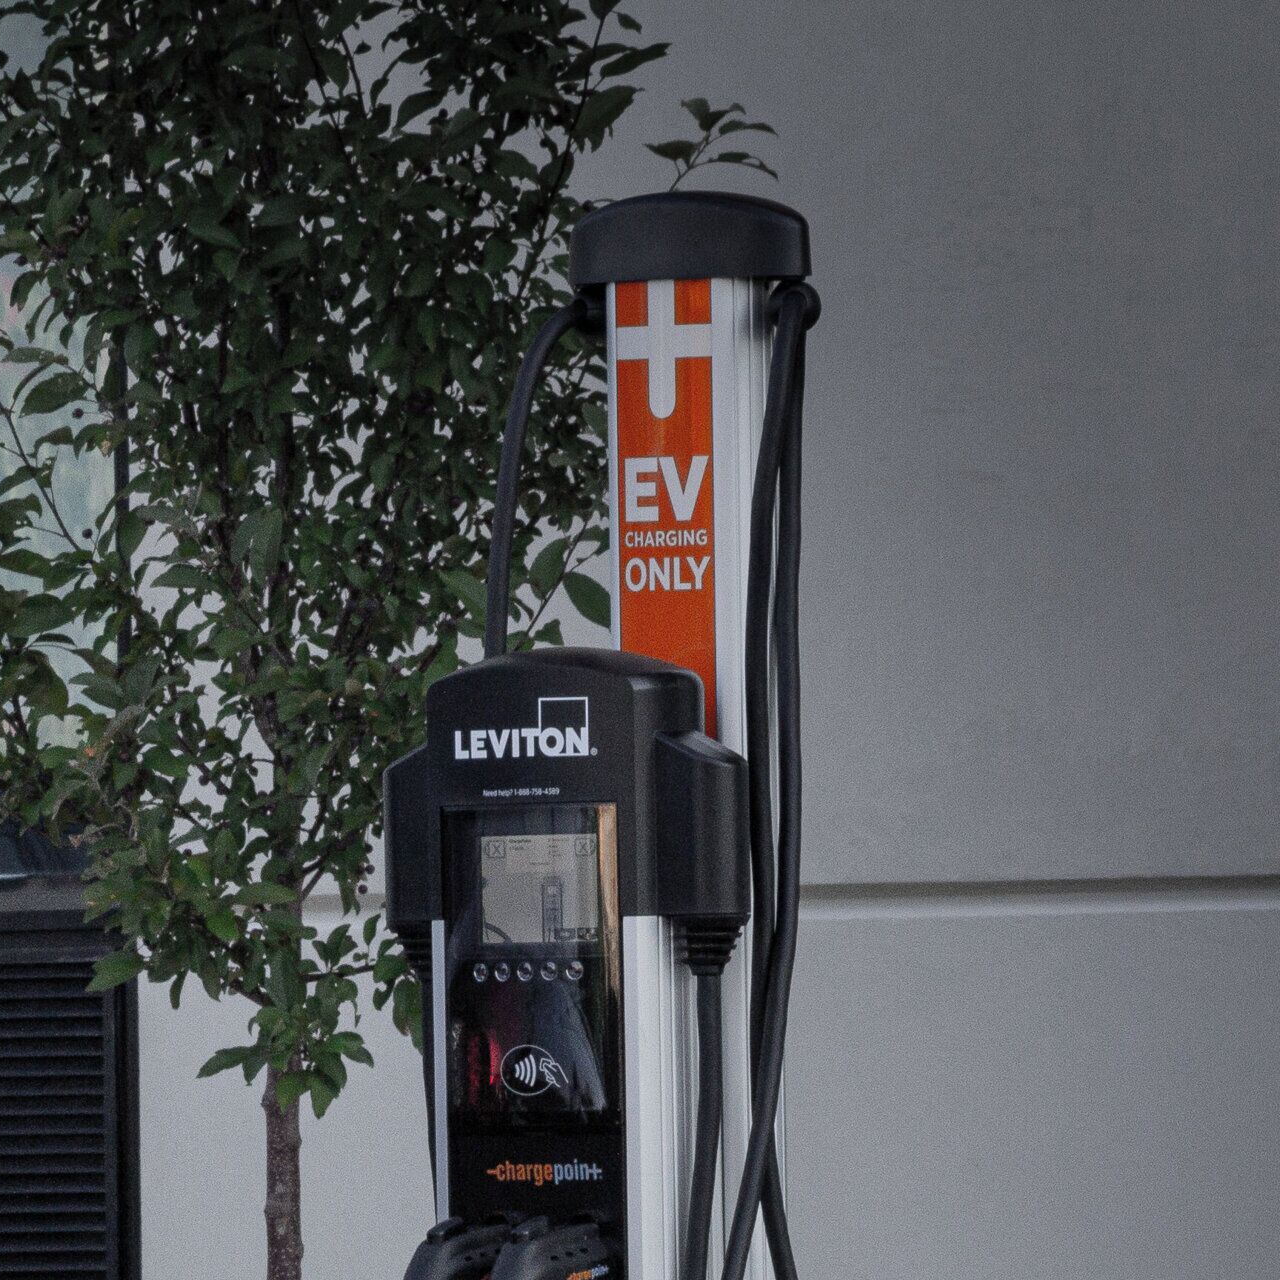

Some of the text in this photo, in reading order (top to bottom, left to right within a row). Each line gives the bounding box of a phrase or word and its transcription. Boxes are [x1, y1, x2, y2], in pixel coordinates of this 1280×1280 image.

[624, 456, 709, 523] EV
[624, 528, 708, 548] CHARGING
[624, 555, 711, 592] ONLY
[454, 726, 590, 760] LEVITON
[482, 789, 498, 797] Need
[498, 788, 513, 798] help?
